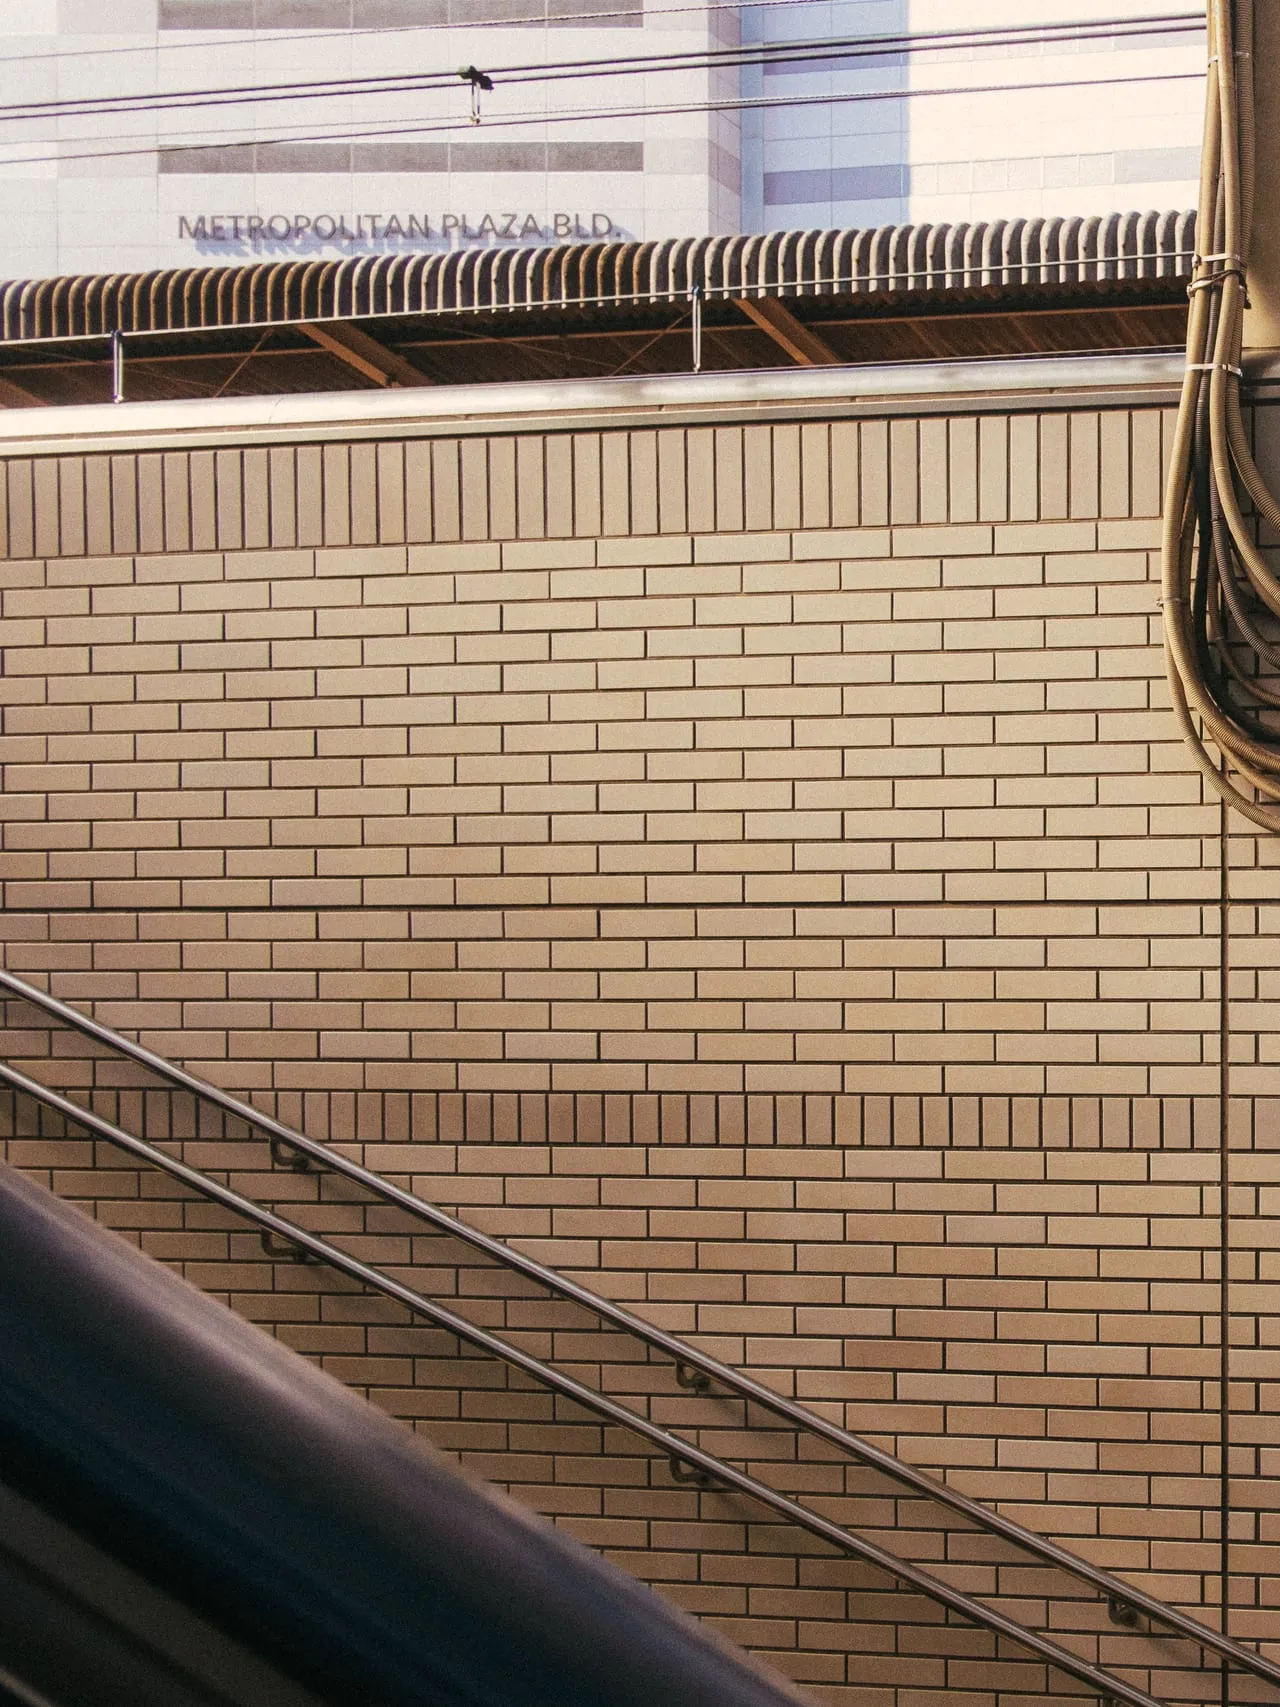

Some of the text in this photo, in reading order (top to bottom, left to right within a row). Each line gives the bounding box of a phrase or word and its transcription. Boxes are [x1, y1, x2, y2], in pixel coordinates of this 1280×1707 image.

[178, 213, 621, 240] METROPOLITAN PLAZA BLD.
